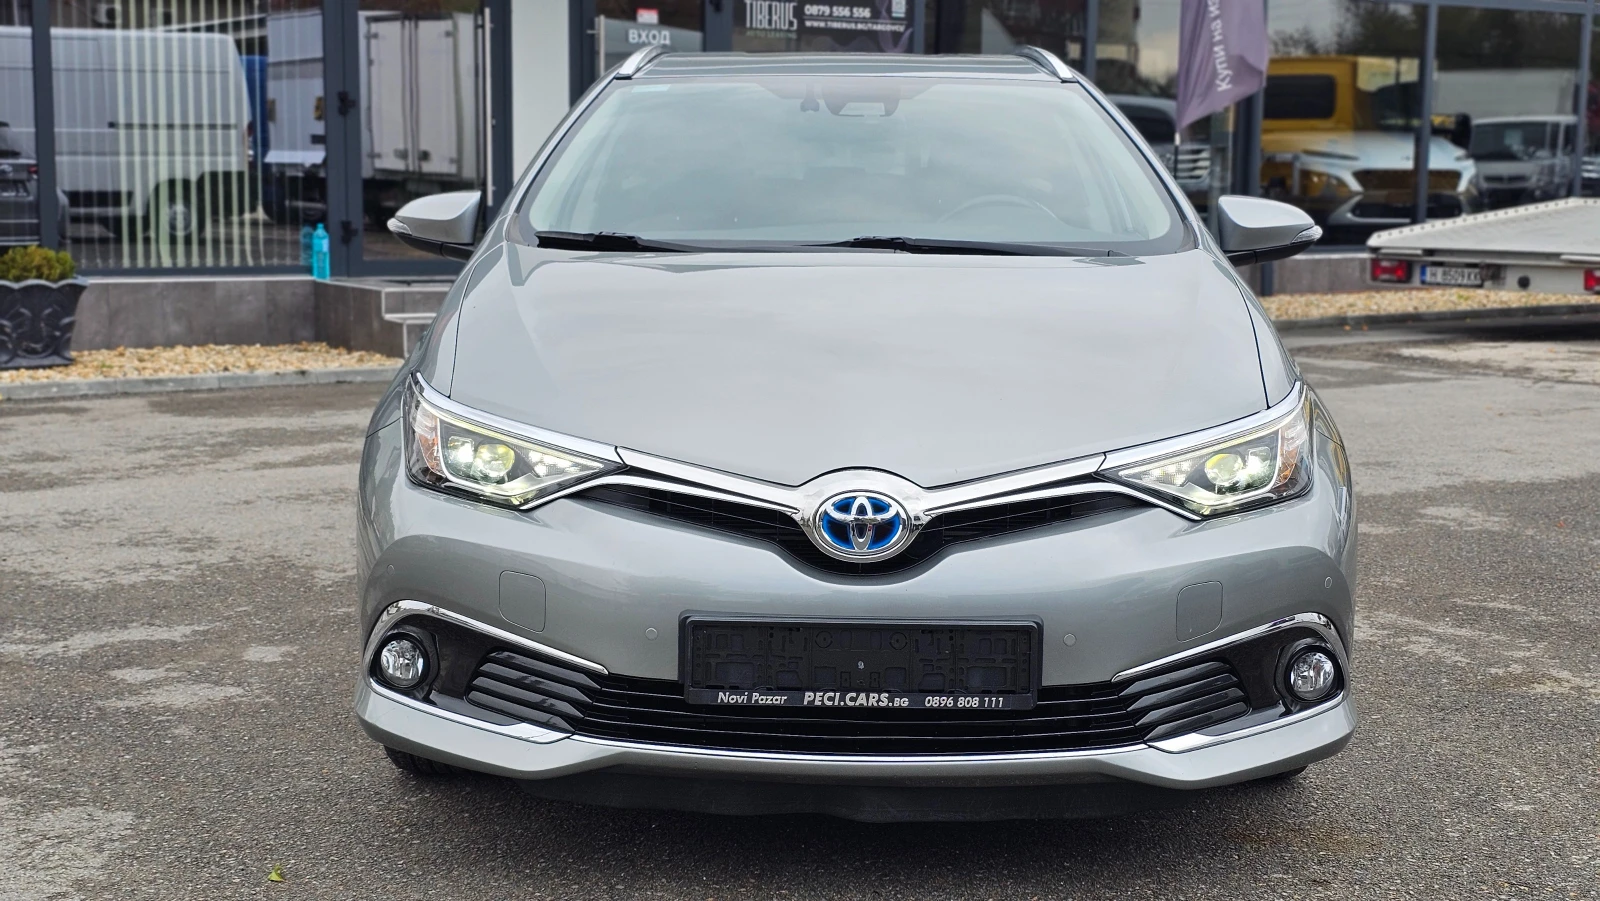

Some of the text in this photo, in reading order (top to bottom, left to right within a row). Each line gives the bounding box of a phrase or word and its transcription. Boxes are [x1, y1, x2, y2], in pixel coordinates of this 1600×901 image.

[744, 0, 798, 31] TIBERUS
[804, 4, 871, 18] 0879 556 556
[629, 29, 671, 45] ВХОД
[1211, 19, 1223, 42] на
[1213, 44, 1233, 91] Купи
[717, 692, 1004, 708] Novi Pazar PECI.CARS.BG 0896 808 111
